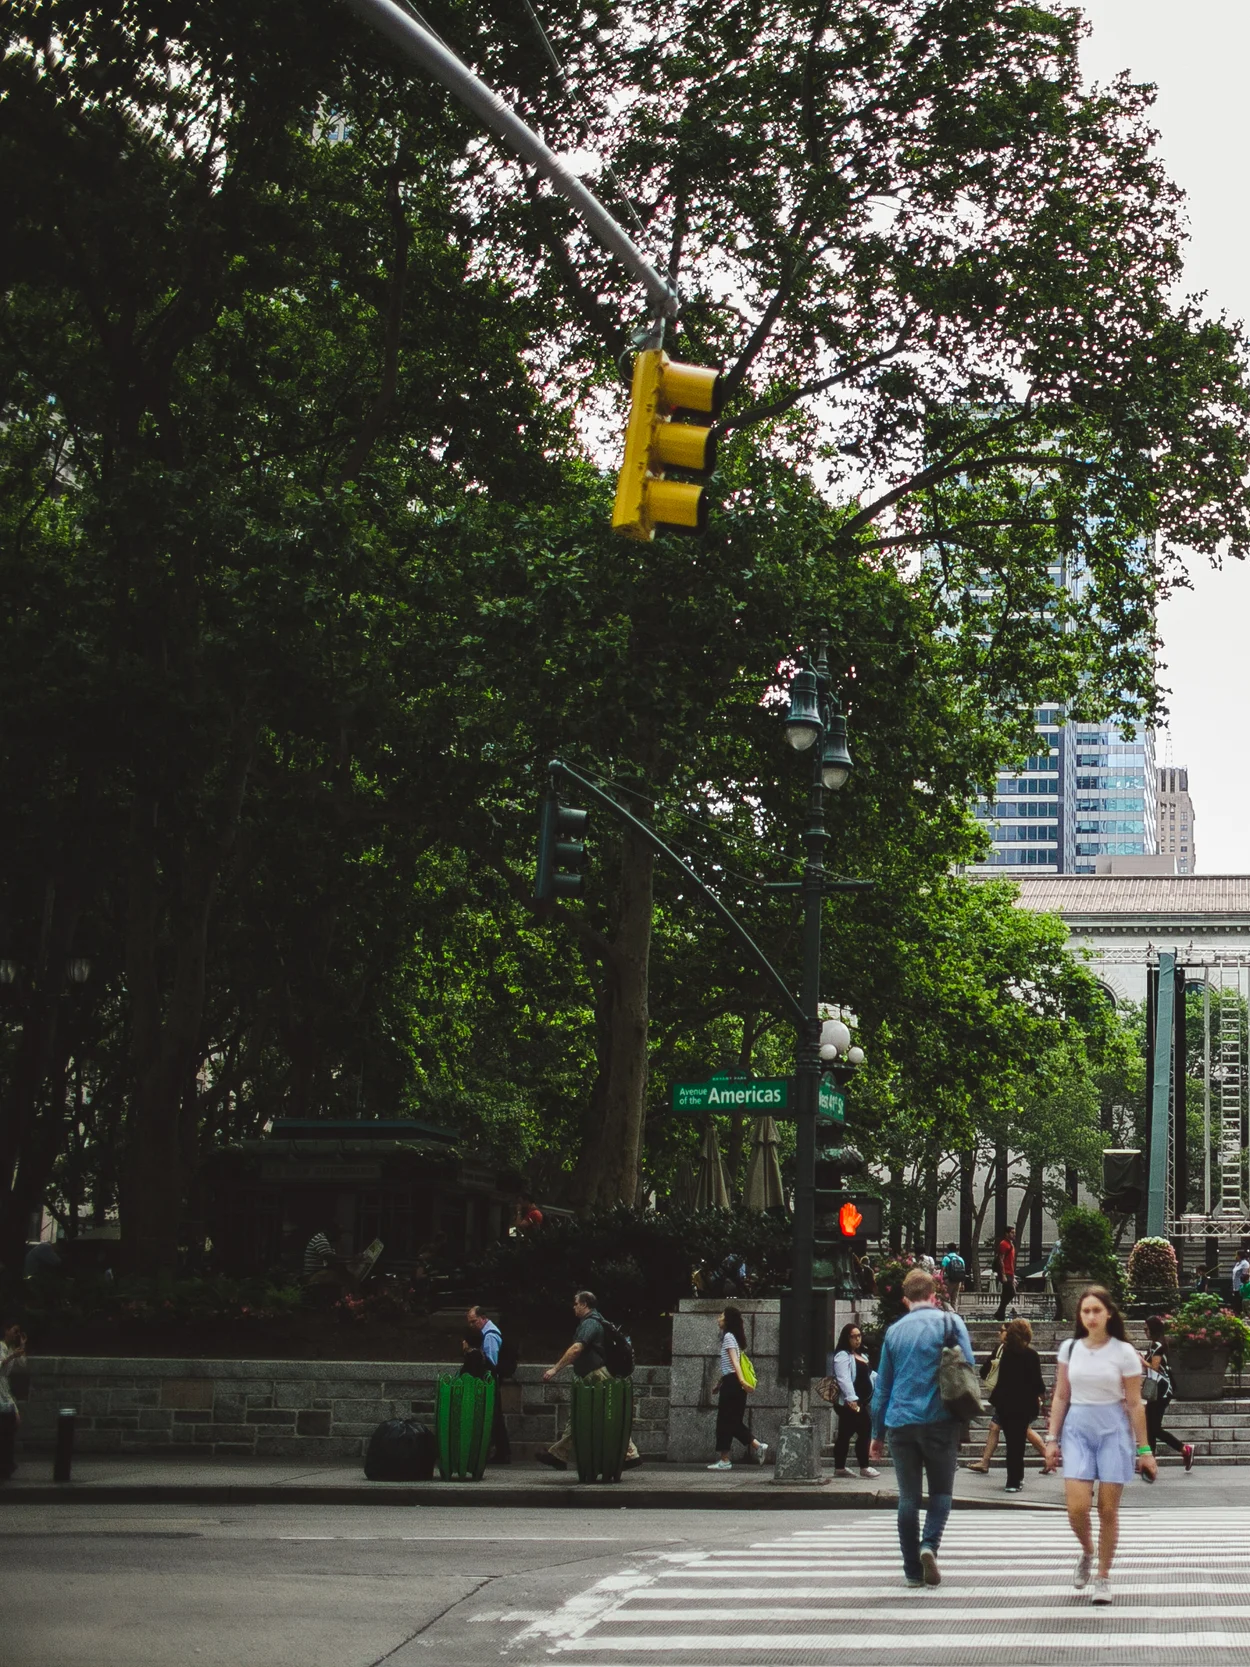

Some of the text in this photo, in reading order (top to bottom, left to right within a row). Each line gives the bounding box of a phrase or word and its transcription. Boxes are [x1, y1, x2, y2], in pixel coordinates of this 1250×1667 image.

[679, 1087, 708, 1096] Avenue
[707, 1085, 781, 1104] Americas
[679, 1096, 702, 1105] of the
